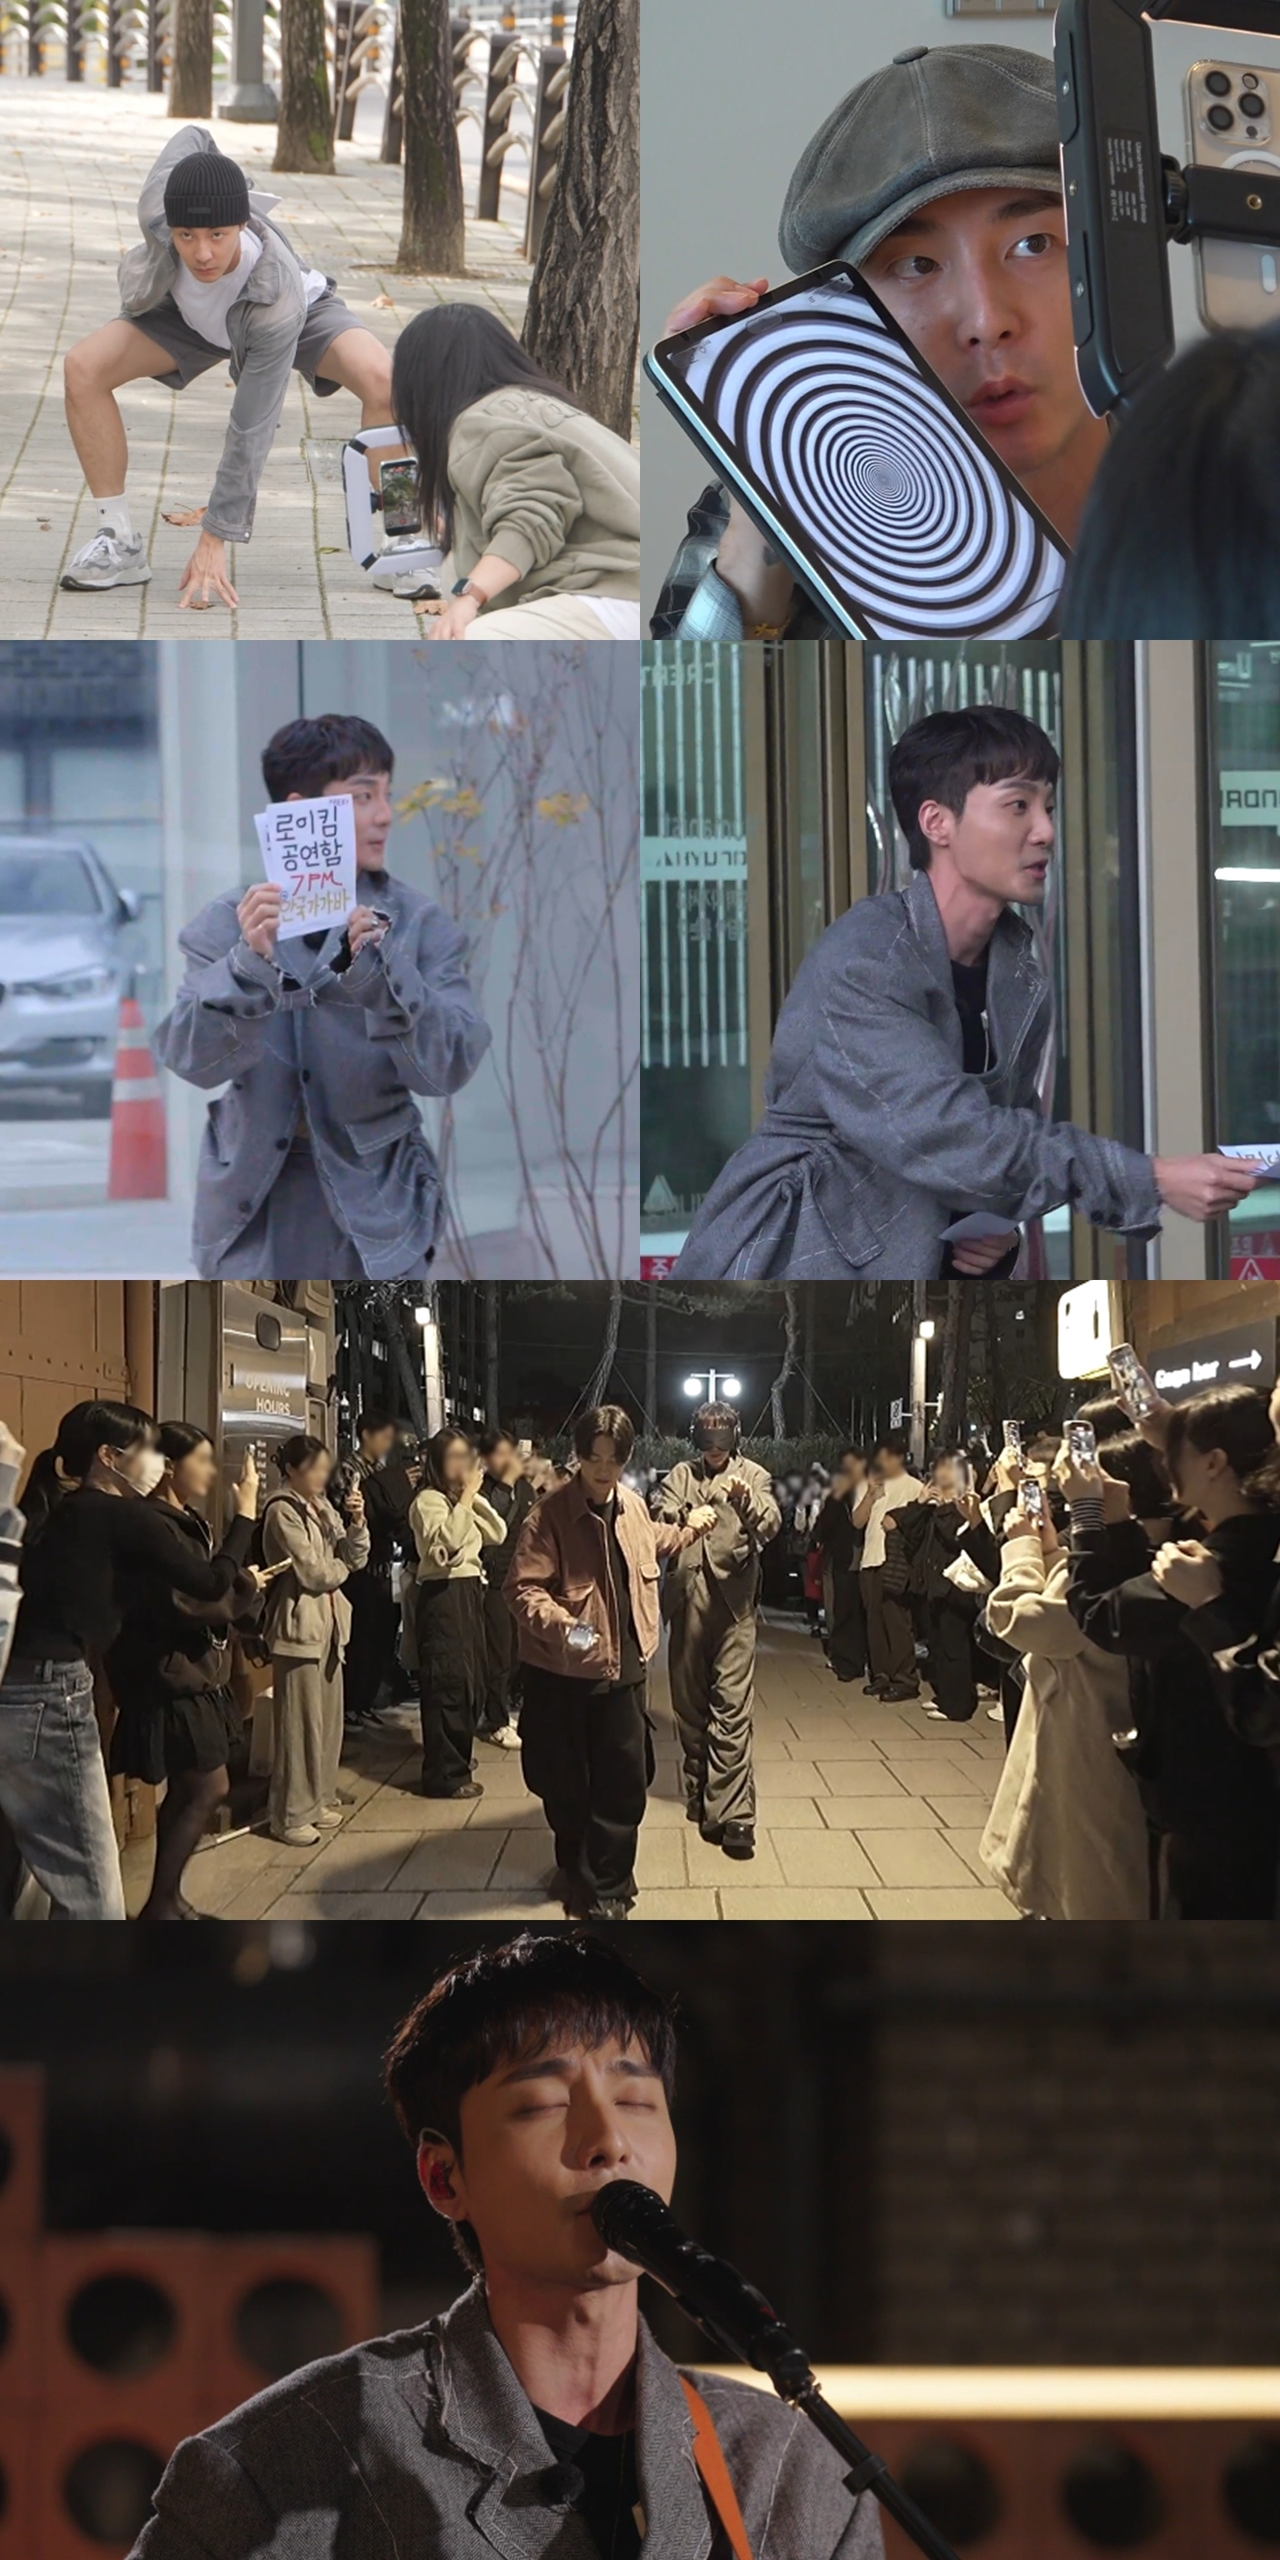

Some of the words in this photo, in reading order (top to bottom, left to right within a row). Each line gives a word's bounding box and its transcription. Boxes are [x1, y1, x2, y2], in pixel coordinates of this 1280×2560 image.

[276, 806, 337, 842] 로이킴
[281, 837, 343, 872] 공연함
[290, 870, 343, 897] 7PM
[245, 1373, 291, 1398] OPENING
[256, 1397, 291, 1416] HOURS
